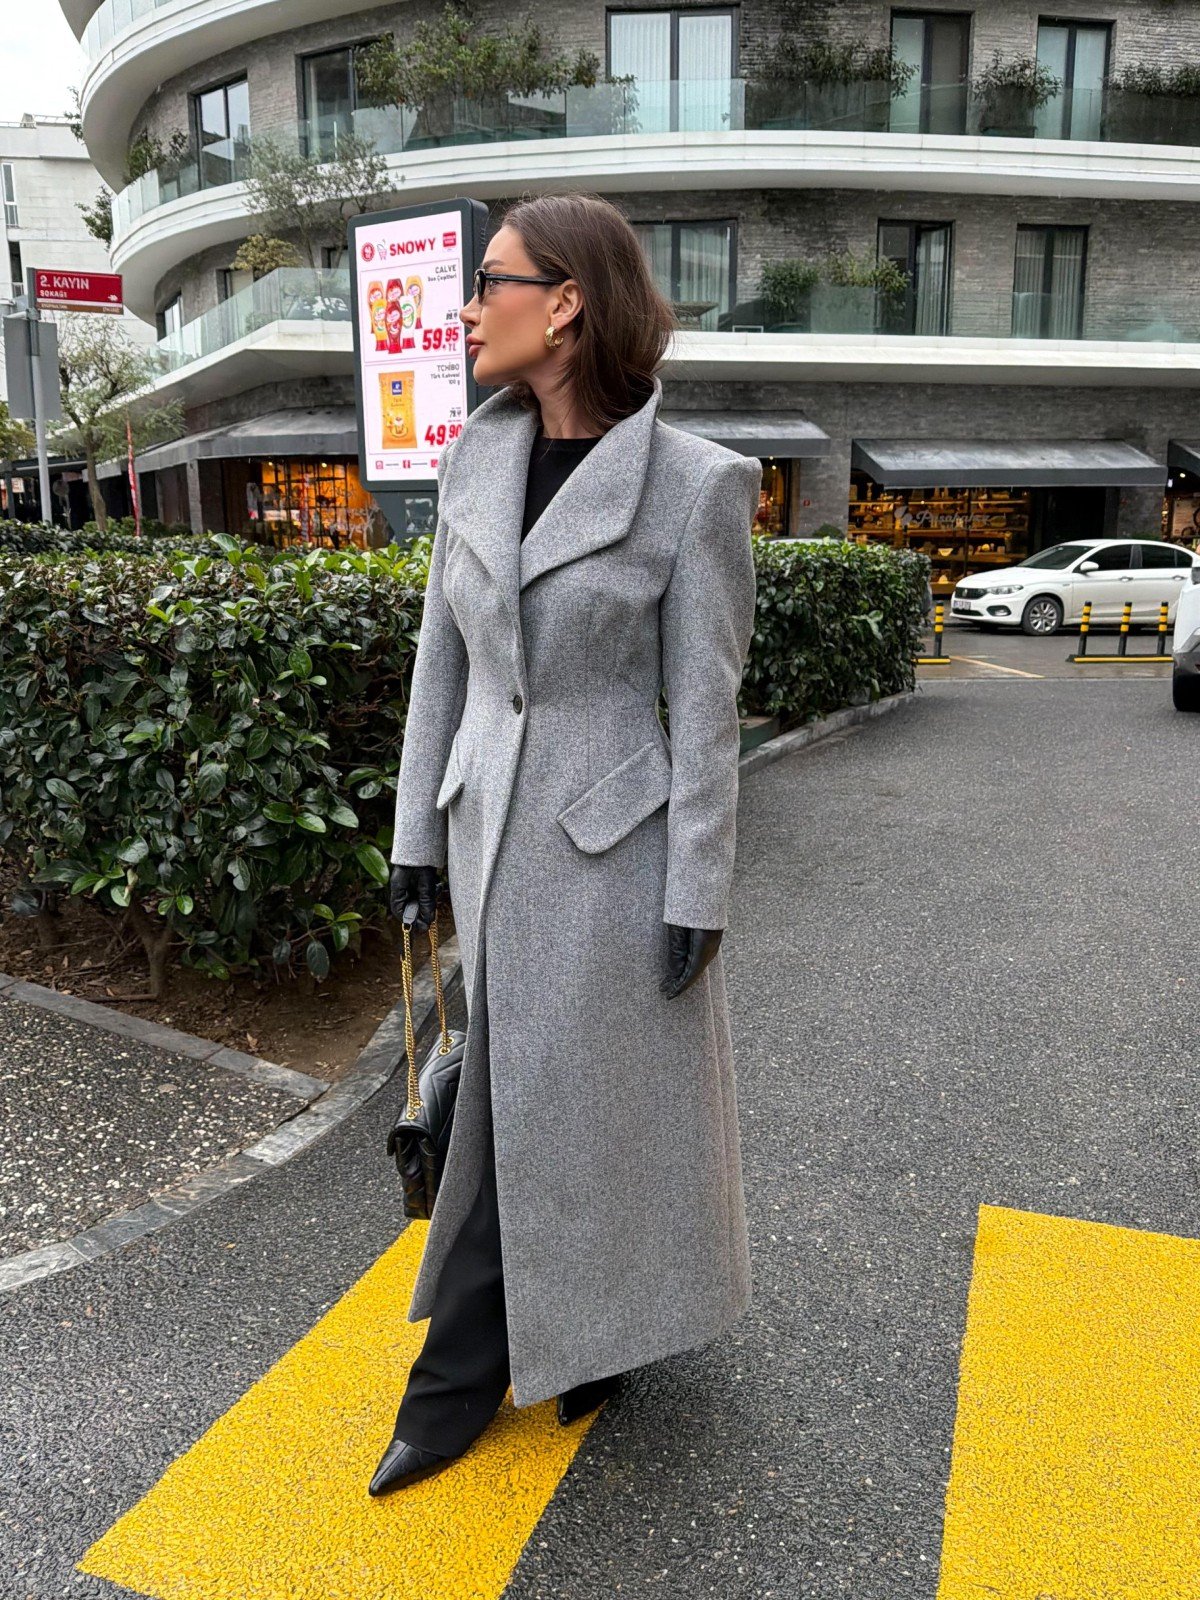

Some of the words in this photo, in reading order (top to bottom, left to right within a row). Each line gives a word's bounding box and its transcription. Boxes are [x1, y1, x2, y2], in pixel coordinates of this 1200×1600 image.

[389, 237, 436, 257] SNOWY
[435, 265, 457, 273] CALVE
[40, 275, 51, 287] 2.
[53, 276, 90, 290] KAYIN
[448, 343, 457, 352] TL
